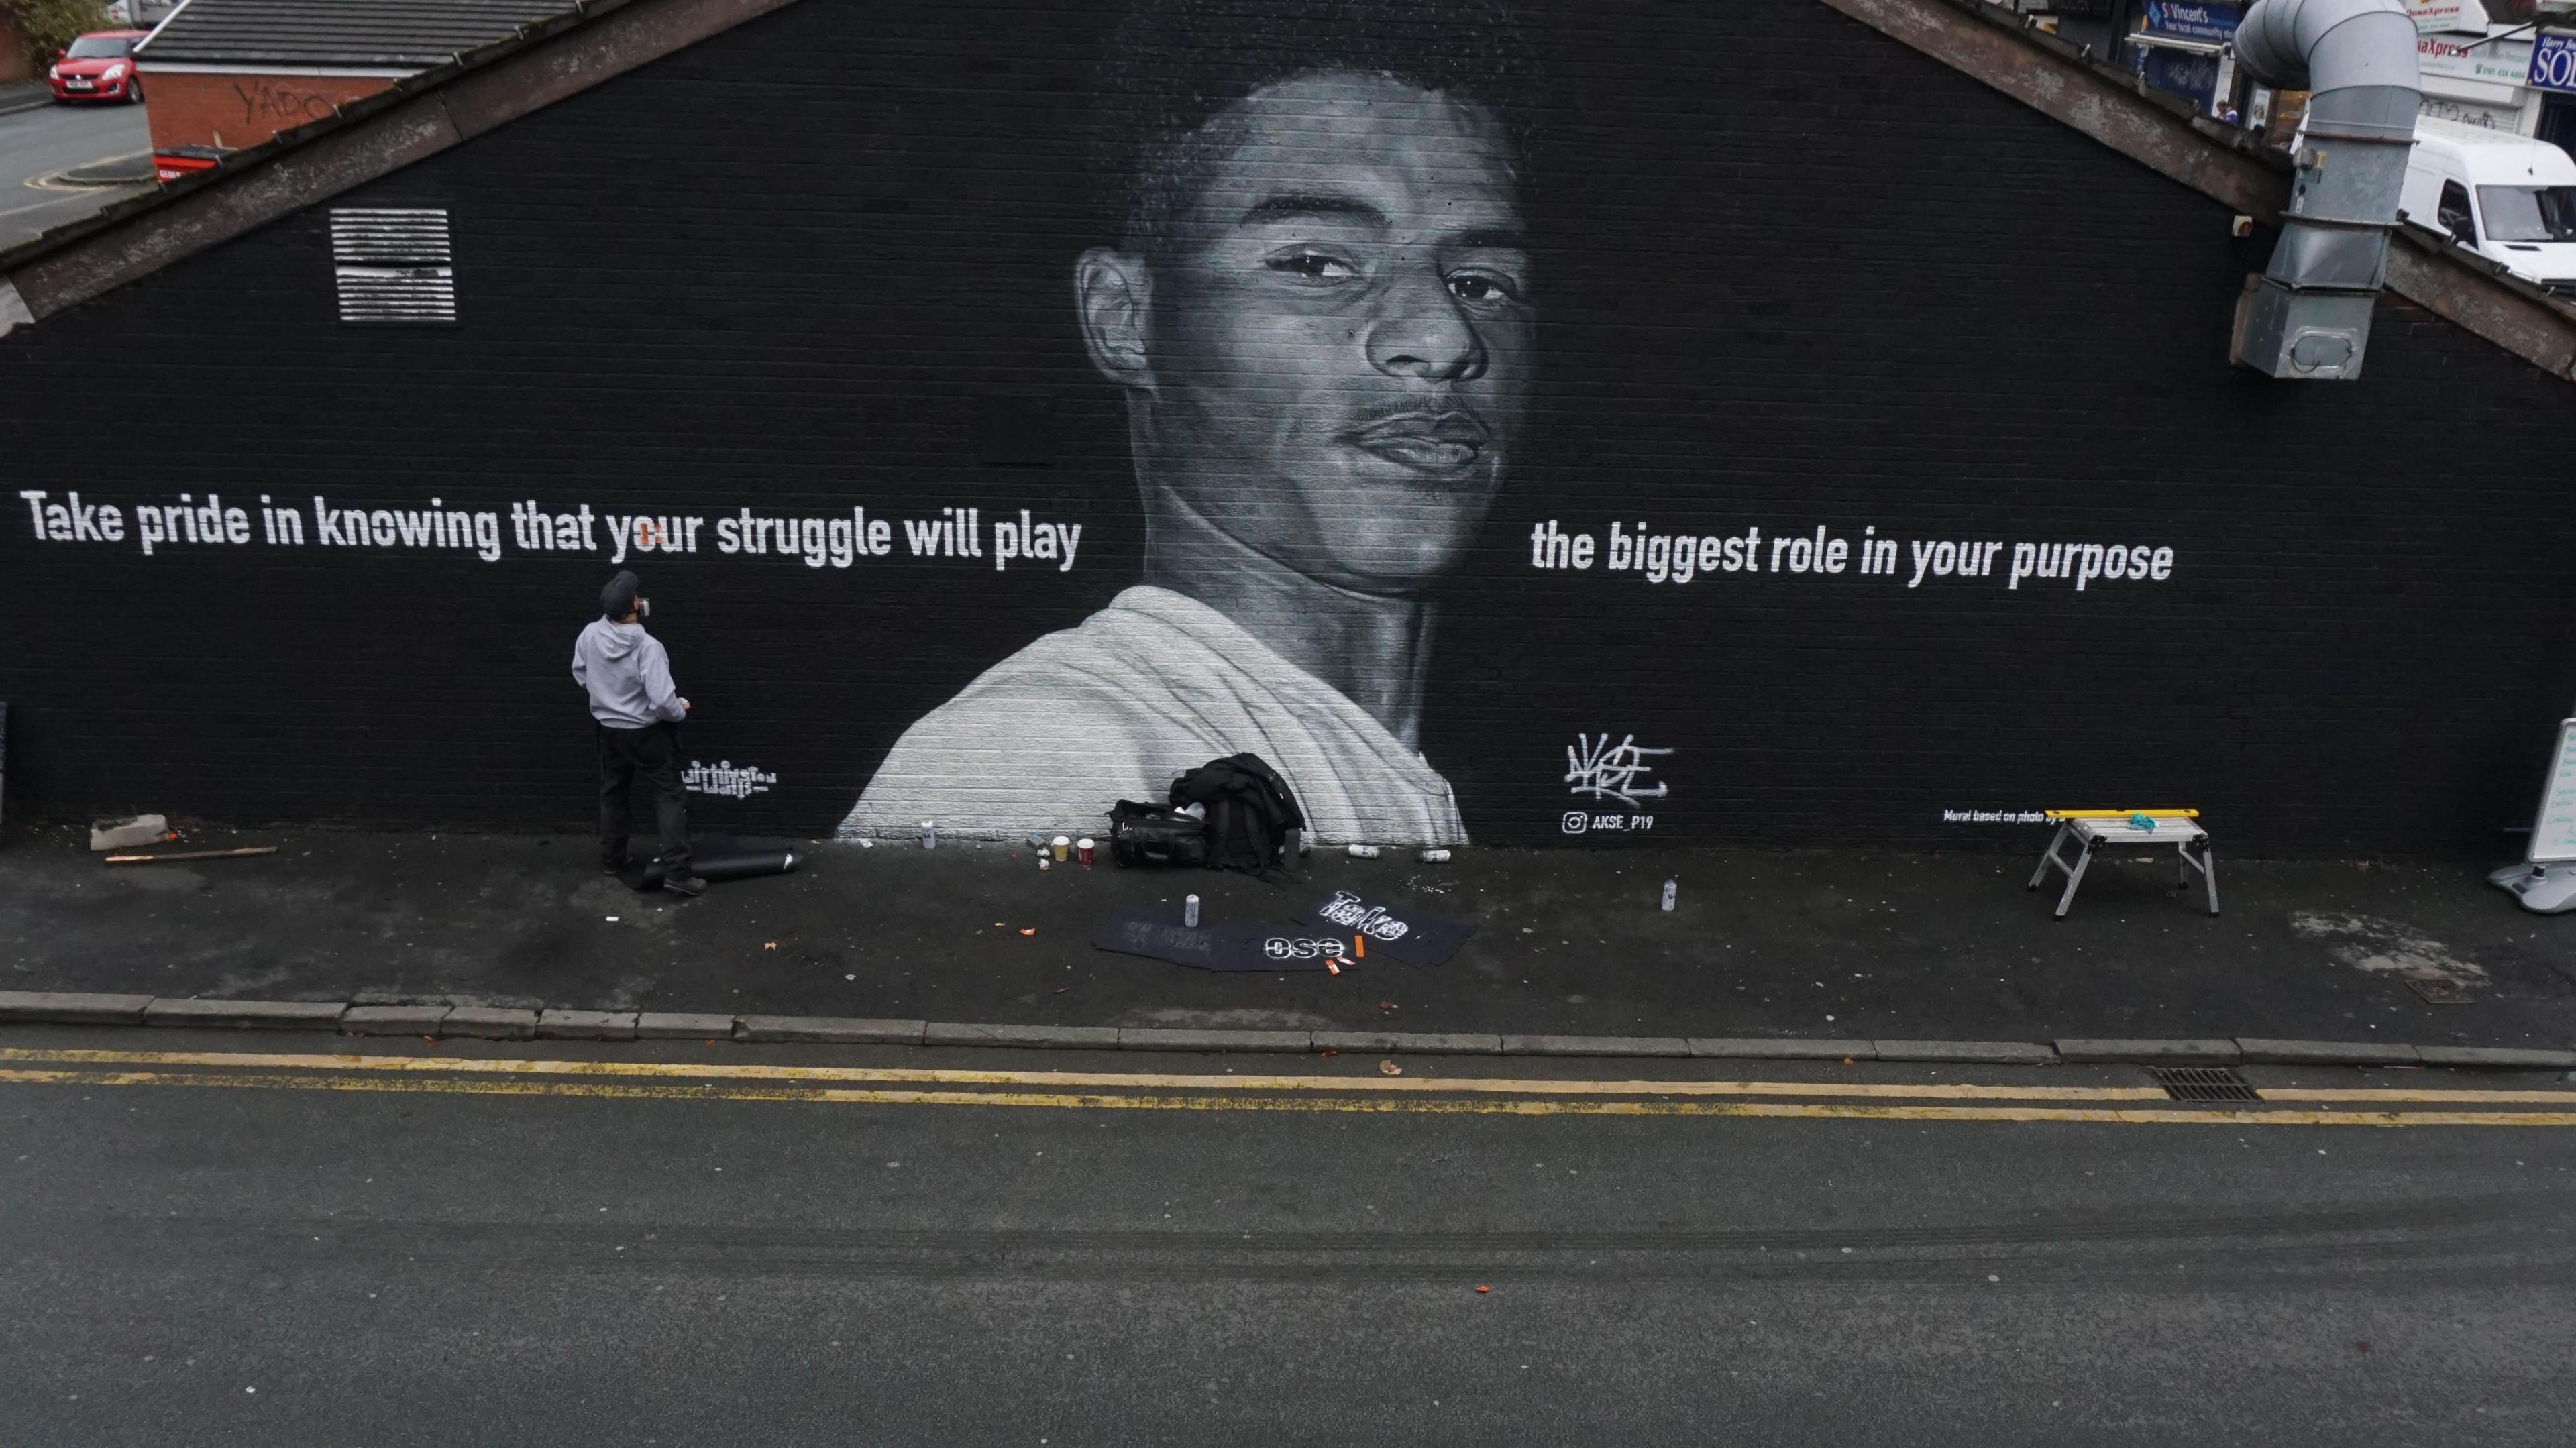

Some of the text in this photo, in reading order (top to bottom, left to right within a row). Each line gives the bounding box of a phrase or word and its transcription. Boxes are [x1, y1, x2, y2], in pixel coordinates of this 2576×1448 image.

[2171, 3, 2208, 23] Vincent's
[2542, 36, 2565, 51] Harry
[21, 491, 1083, 573] Take pride in knowing that your struggle will play
[1531, 520, 2174, 592] the biggest role in your purpose
[1592, 814, 1654, 832] AKSE_P19
[1944, 809, 1972, 822] Mural
[1973, 810, 2002, 822] based
[2003, 813, 2016, 822] on
[2017, 810, 2045, 824] photo
